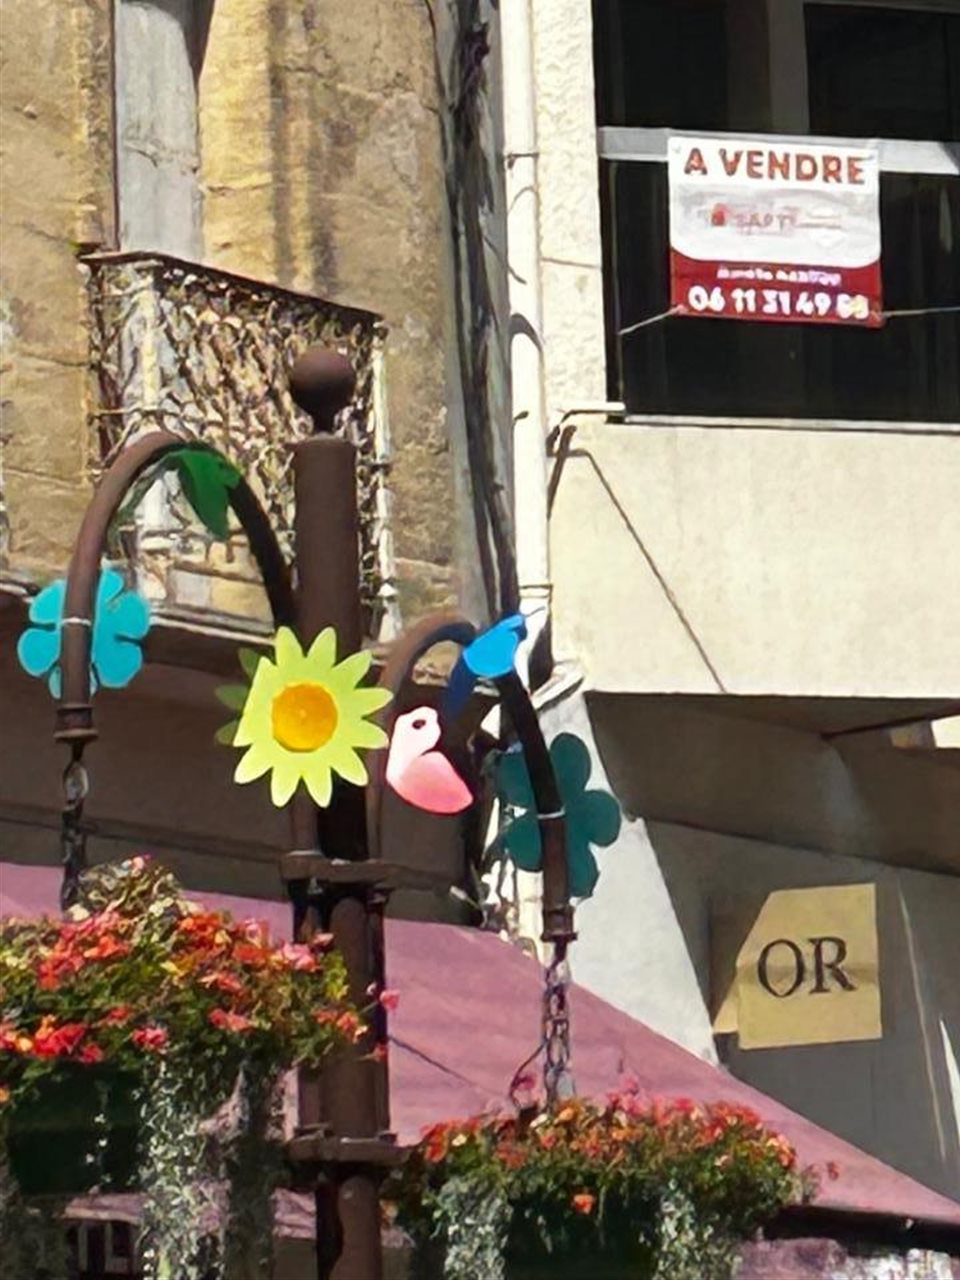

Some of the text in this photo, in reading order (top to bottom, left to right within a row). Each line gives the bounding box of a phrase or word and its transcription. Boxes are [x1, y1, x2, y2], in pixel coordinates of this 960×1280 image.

[684, 147, 866, 186] A VENDRE
[687, 285, 726, 312] 06
[730, 287, 757, 313] 11
[756, 935, 858, 999] OR
